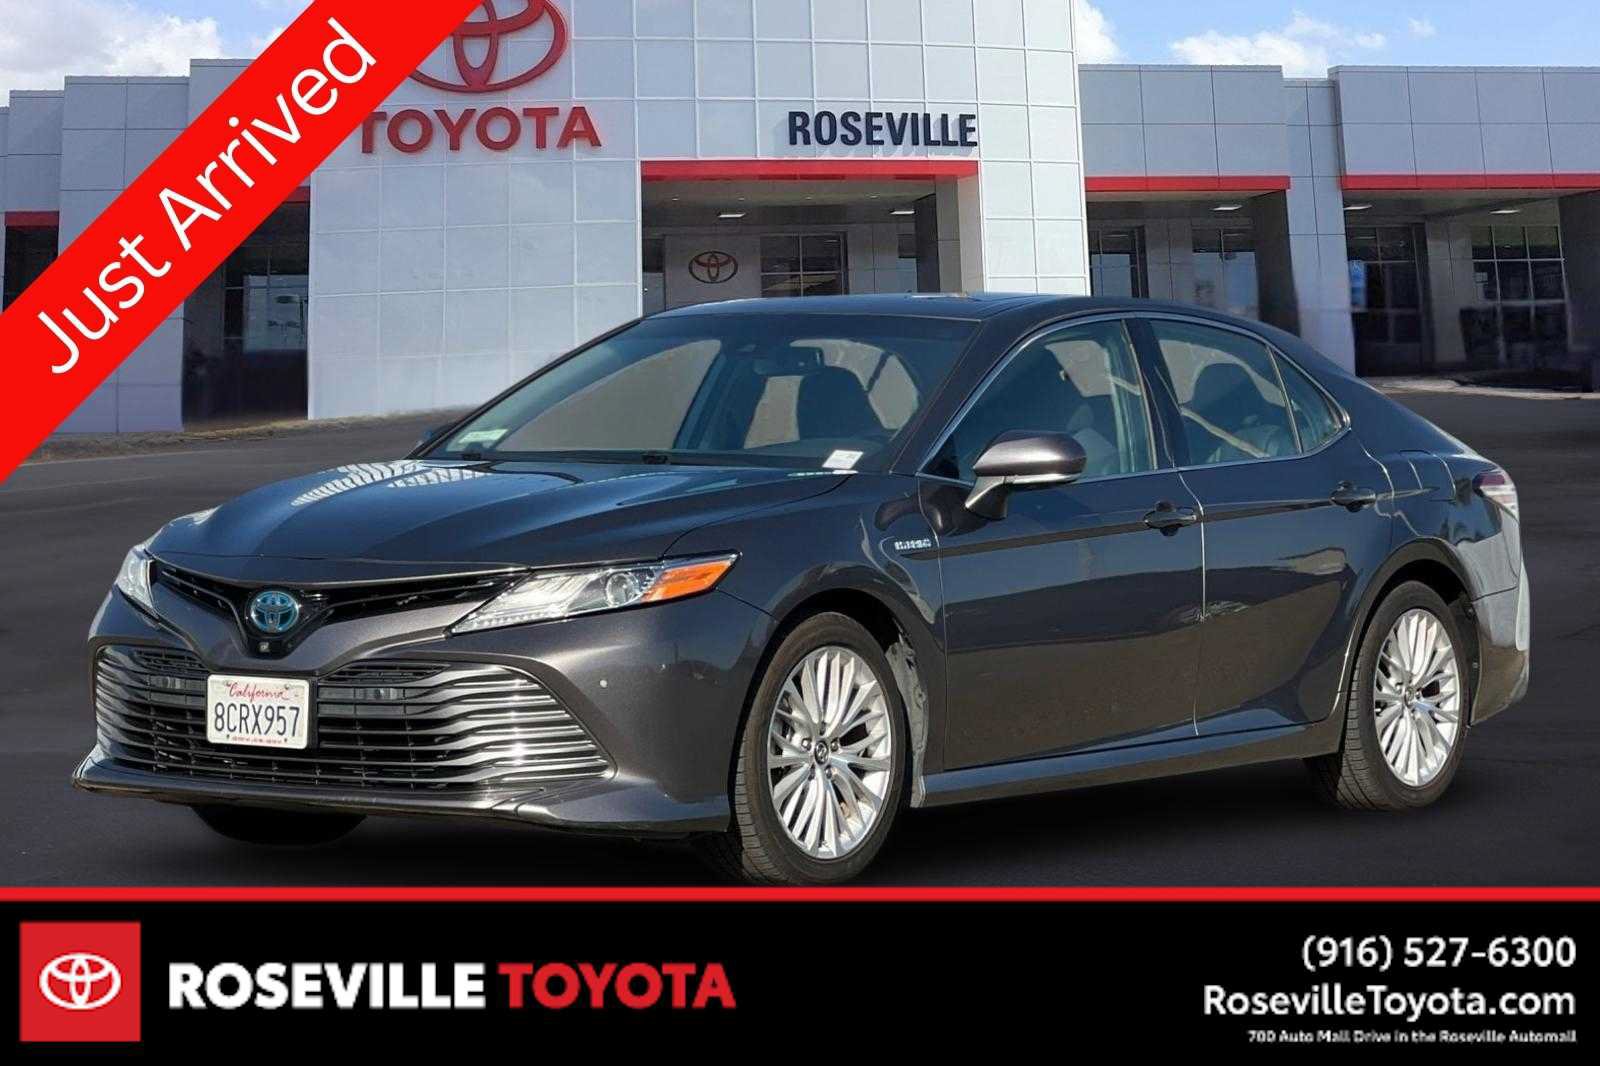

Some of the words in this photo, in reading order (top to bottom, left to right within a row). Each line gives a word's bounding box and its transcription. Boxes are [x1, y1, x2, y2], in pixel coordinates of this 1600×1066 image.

[361, 106, 602, 154] TOYOTA
[788, 111, 978, 147] ROSEVILLE
[214, 702, 300, 737] 8CRX957
